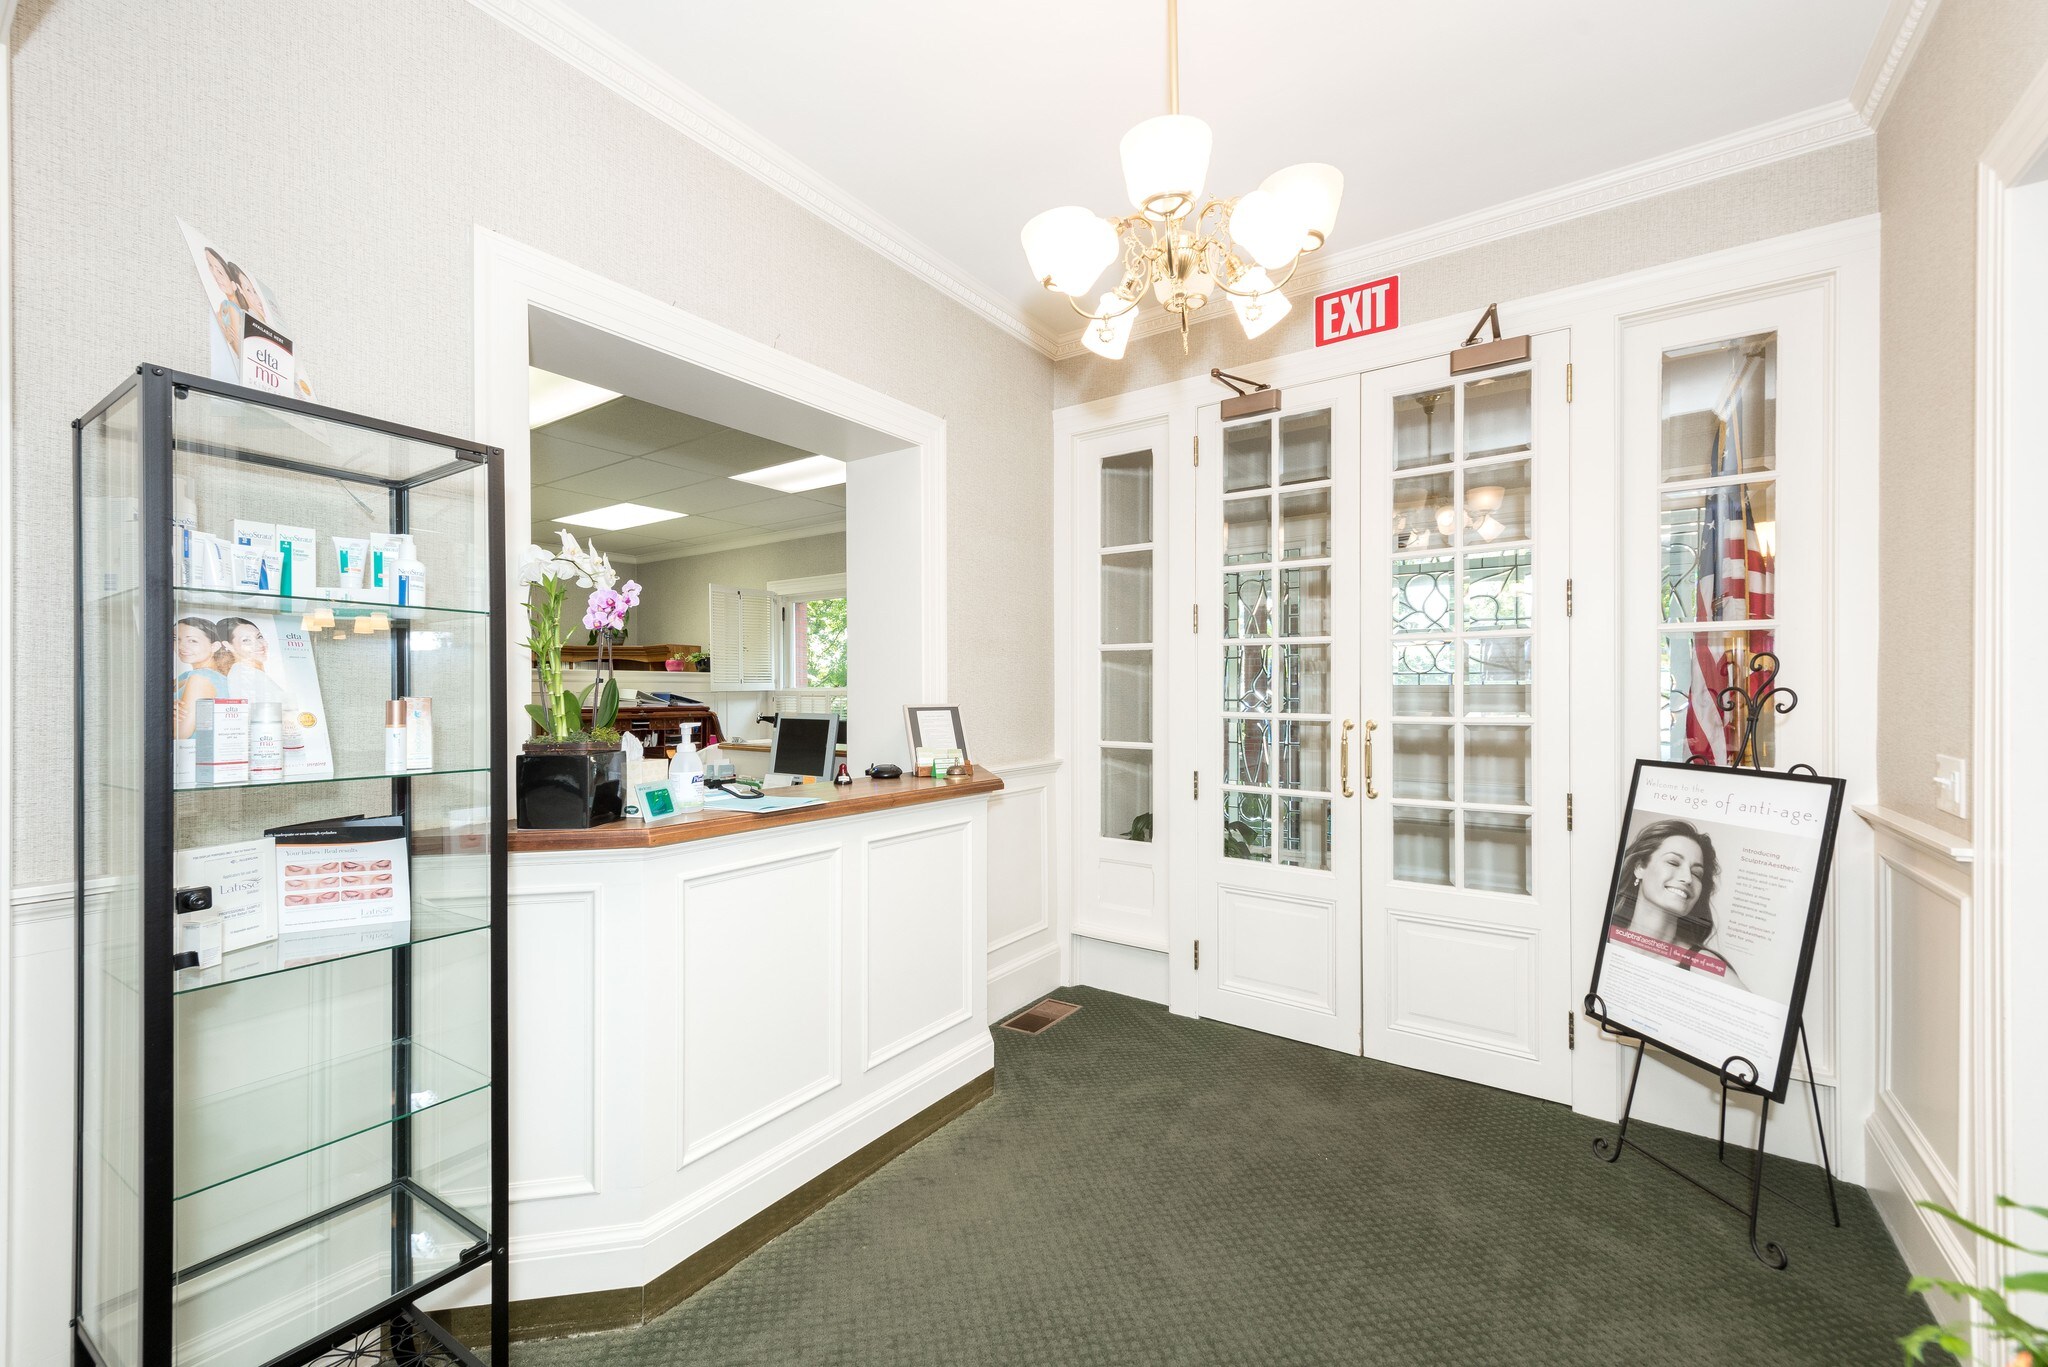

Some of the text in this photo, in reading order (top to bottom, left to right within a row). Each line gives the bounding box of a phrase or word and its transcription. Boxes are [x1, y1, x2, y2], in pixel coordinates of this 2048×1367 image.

[1323, 283, 1390, 341] EXIT
[252, 322, 284, 344] AVAILABLE HERE
[256, 348, 279, 370] elta
[286, 632, 302, 640] elta
[1646, 778, 1705, 793] Welcome to the
[1653, 791, 1818, 826] new age of anti-age.
[1742, 847, 1781, 860] Introducing
[1691, 956, 1699, 964] age
[1700, 958, 1706, 966] of
[1706, 961, 1724, 972] anti-age
